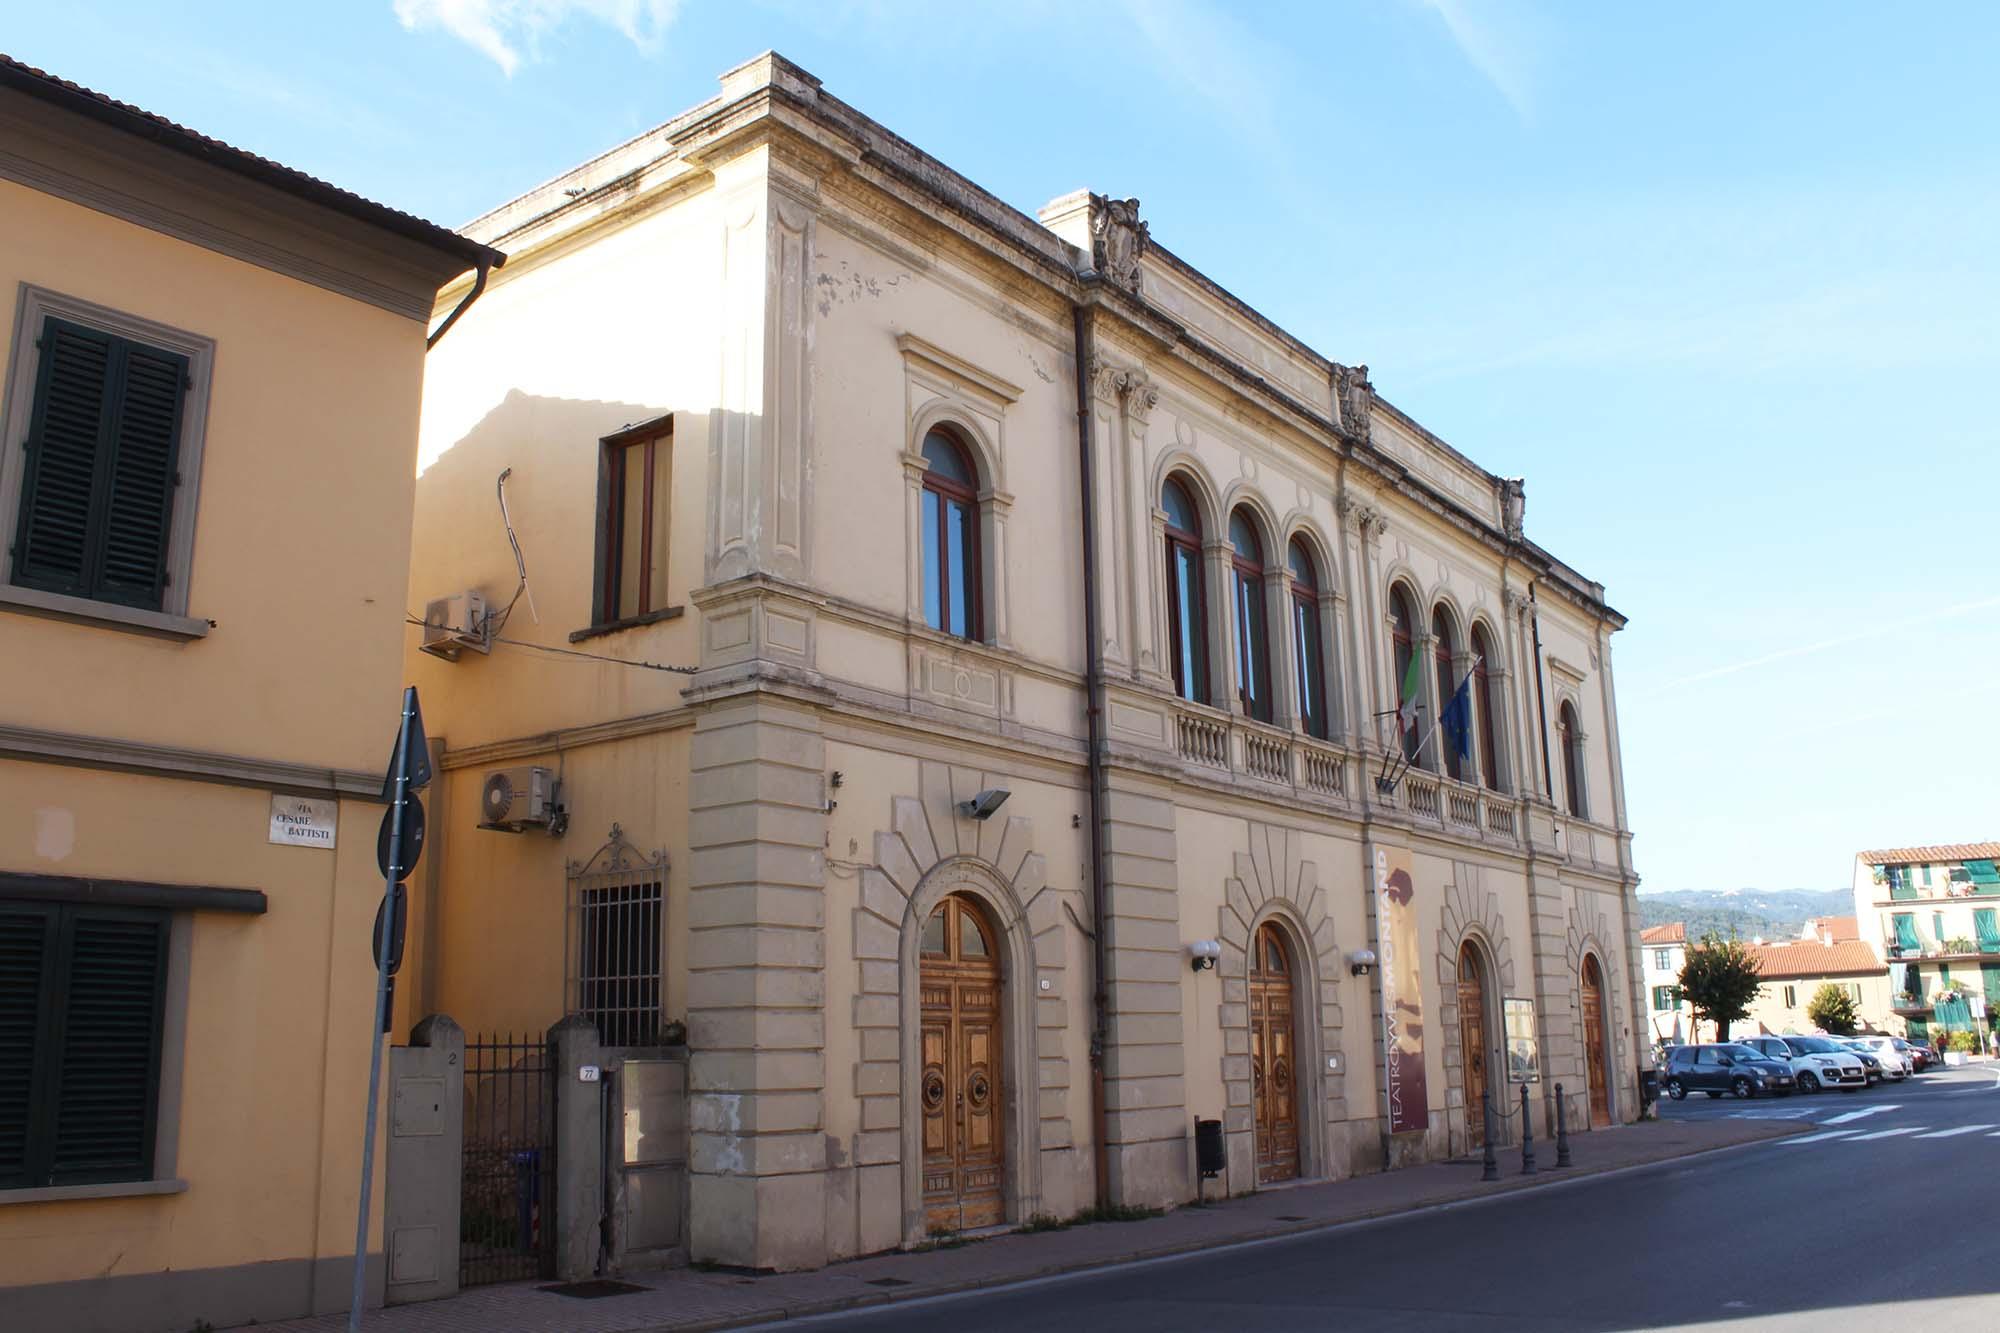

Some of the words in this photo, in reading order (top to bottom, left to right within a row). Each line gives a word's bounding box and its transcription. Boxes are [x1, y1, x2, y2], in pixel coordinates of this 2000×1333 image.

[296, 804, 312, 814] VIA
[276, 814, 311, 825] CESARE
[288, 827, 329, 839] BATTISTI
[448, 1050, 457, 1065] 2
[584, 1069, 594, 1078] 77
